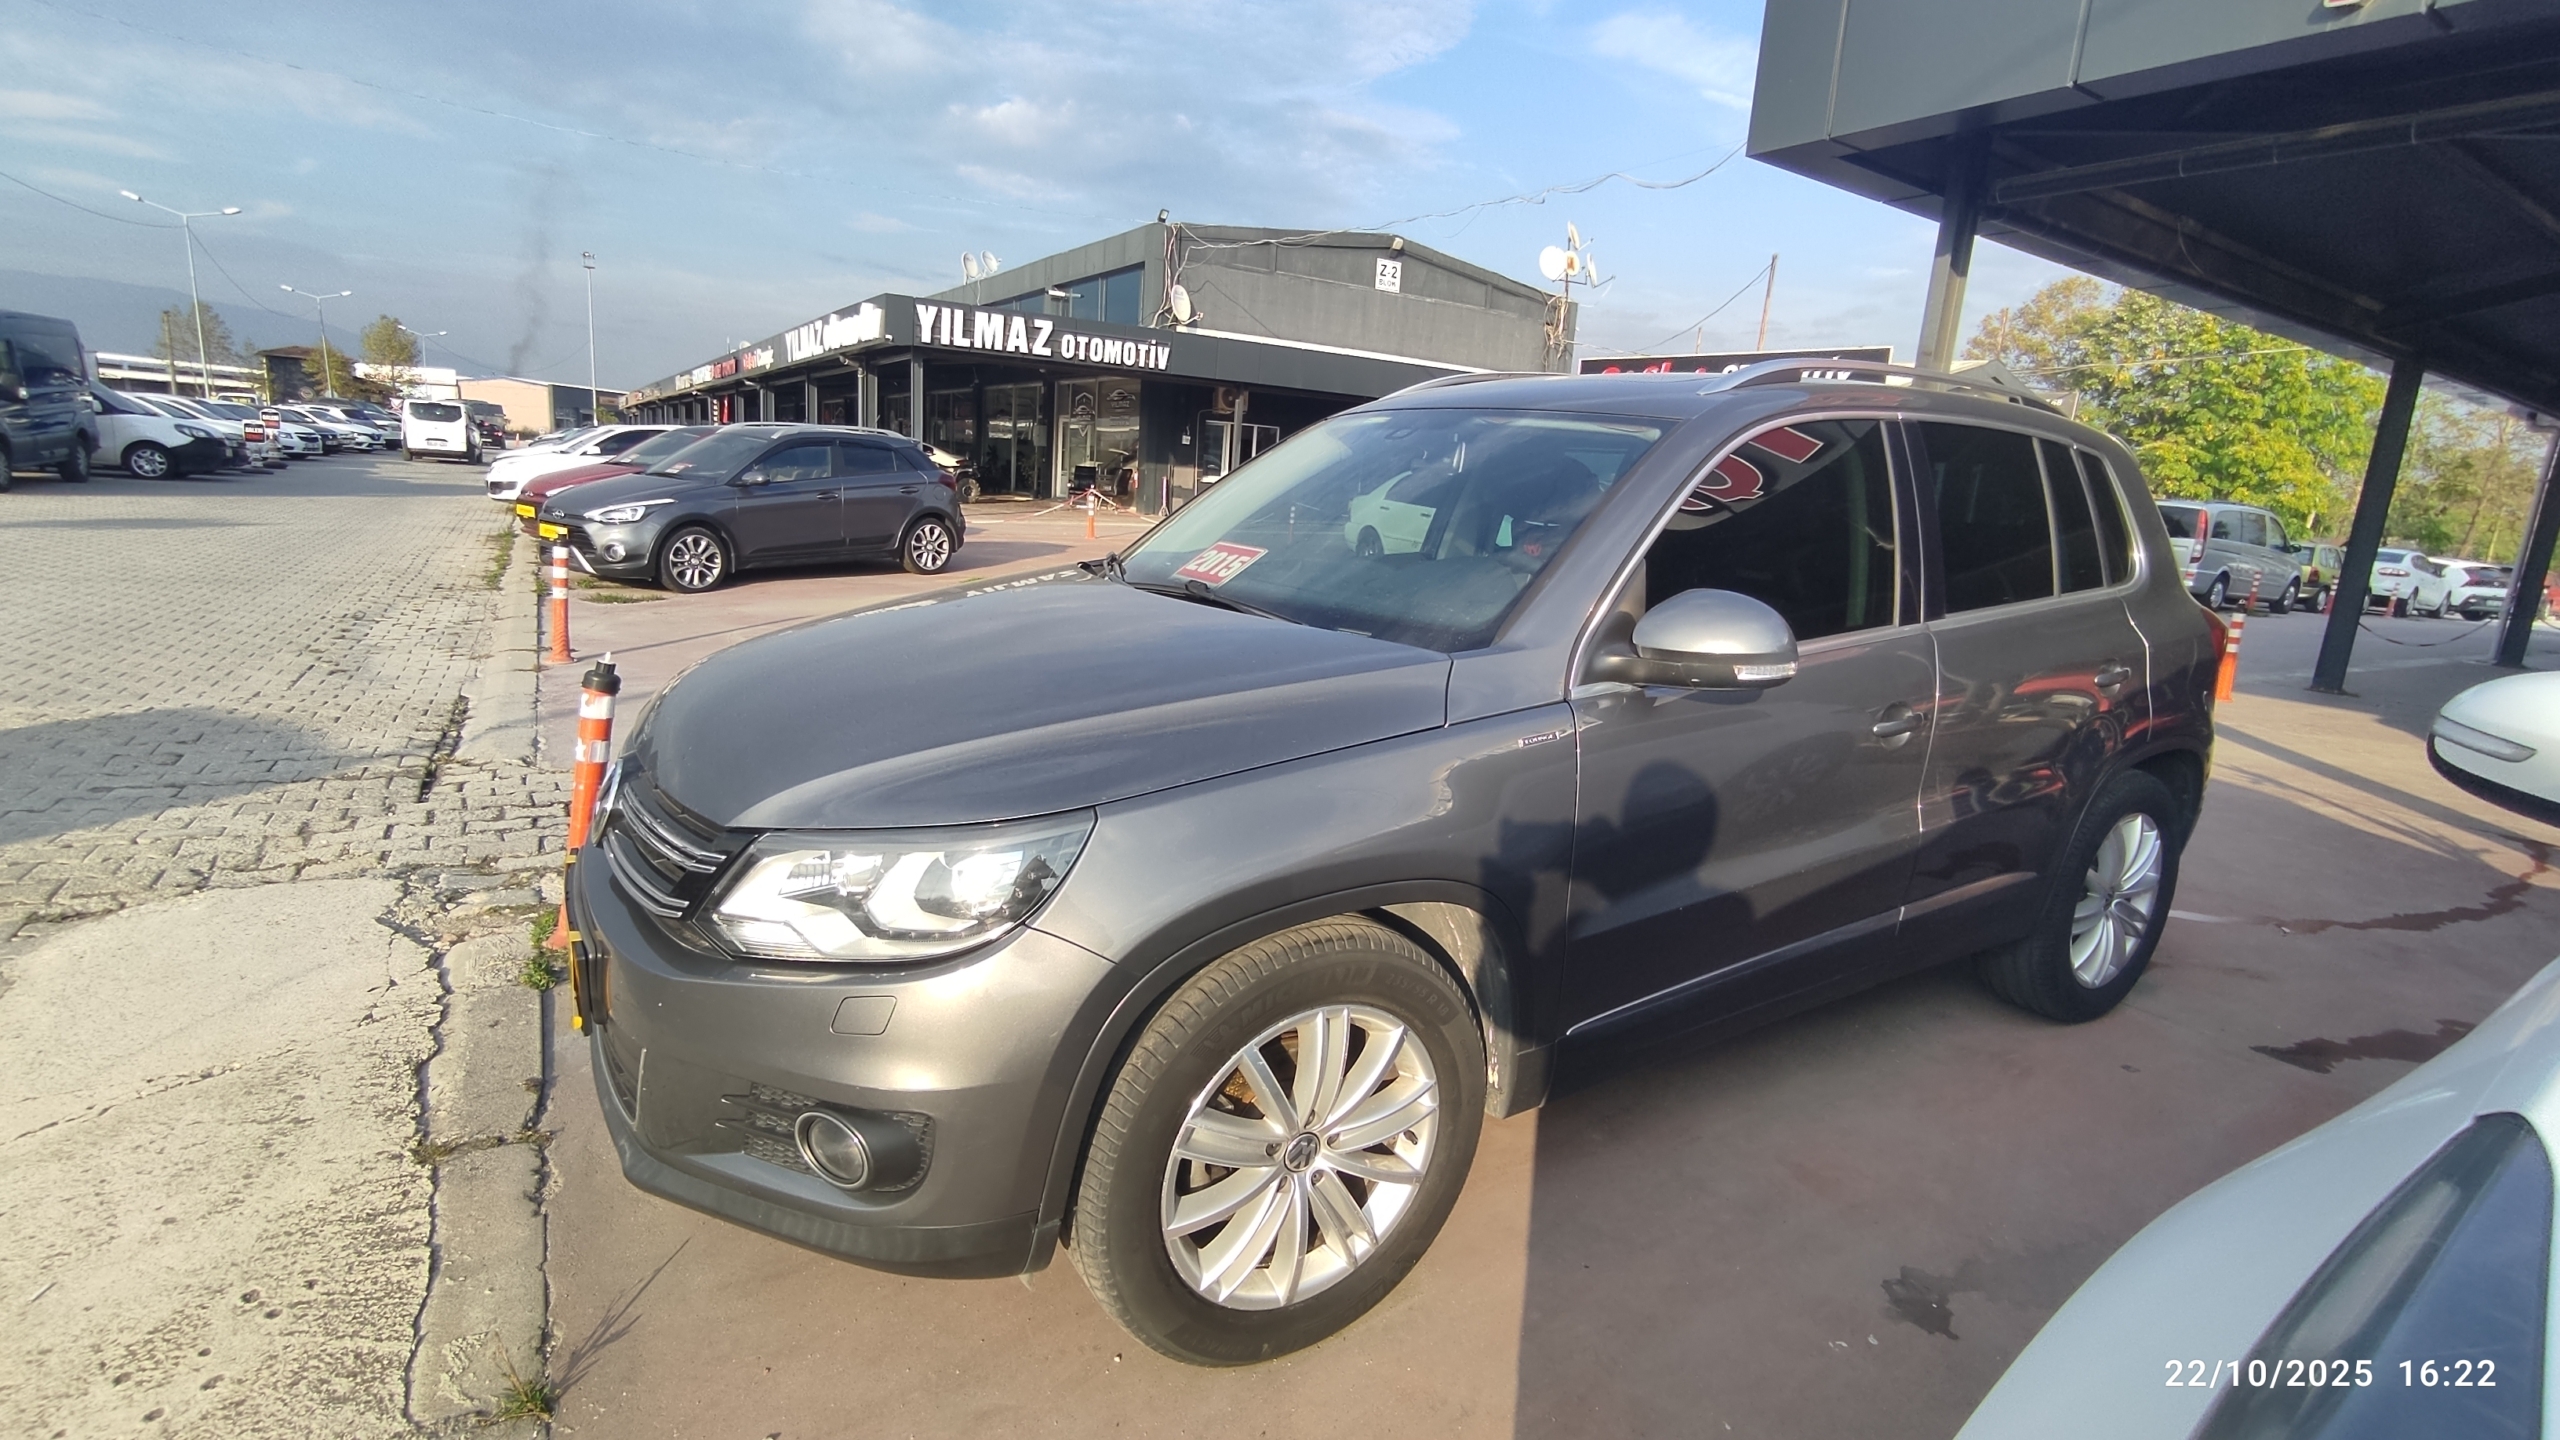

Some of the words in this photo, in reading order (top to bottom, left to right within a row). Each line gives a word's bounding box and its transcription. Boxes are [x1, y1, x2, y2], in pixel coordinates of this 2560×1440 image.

[1380, 264, 1398, 279] Z-2
[784, 319, 824, 363] YILMAZ
[915, 304, 1053, 357] YILMAZ
[1060, 334, 1171, 370] OTOMOTİV
[1185, 549, 1251, 578] 2015
